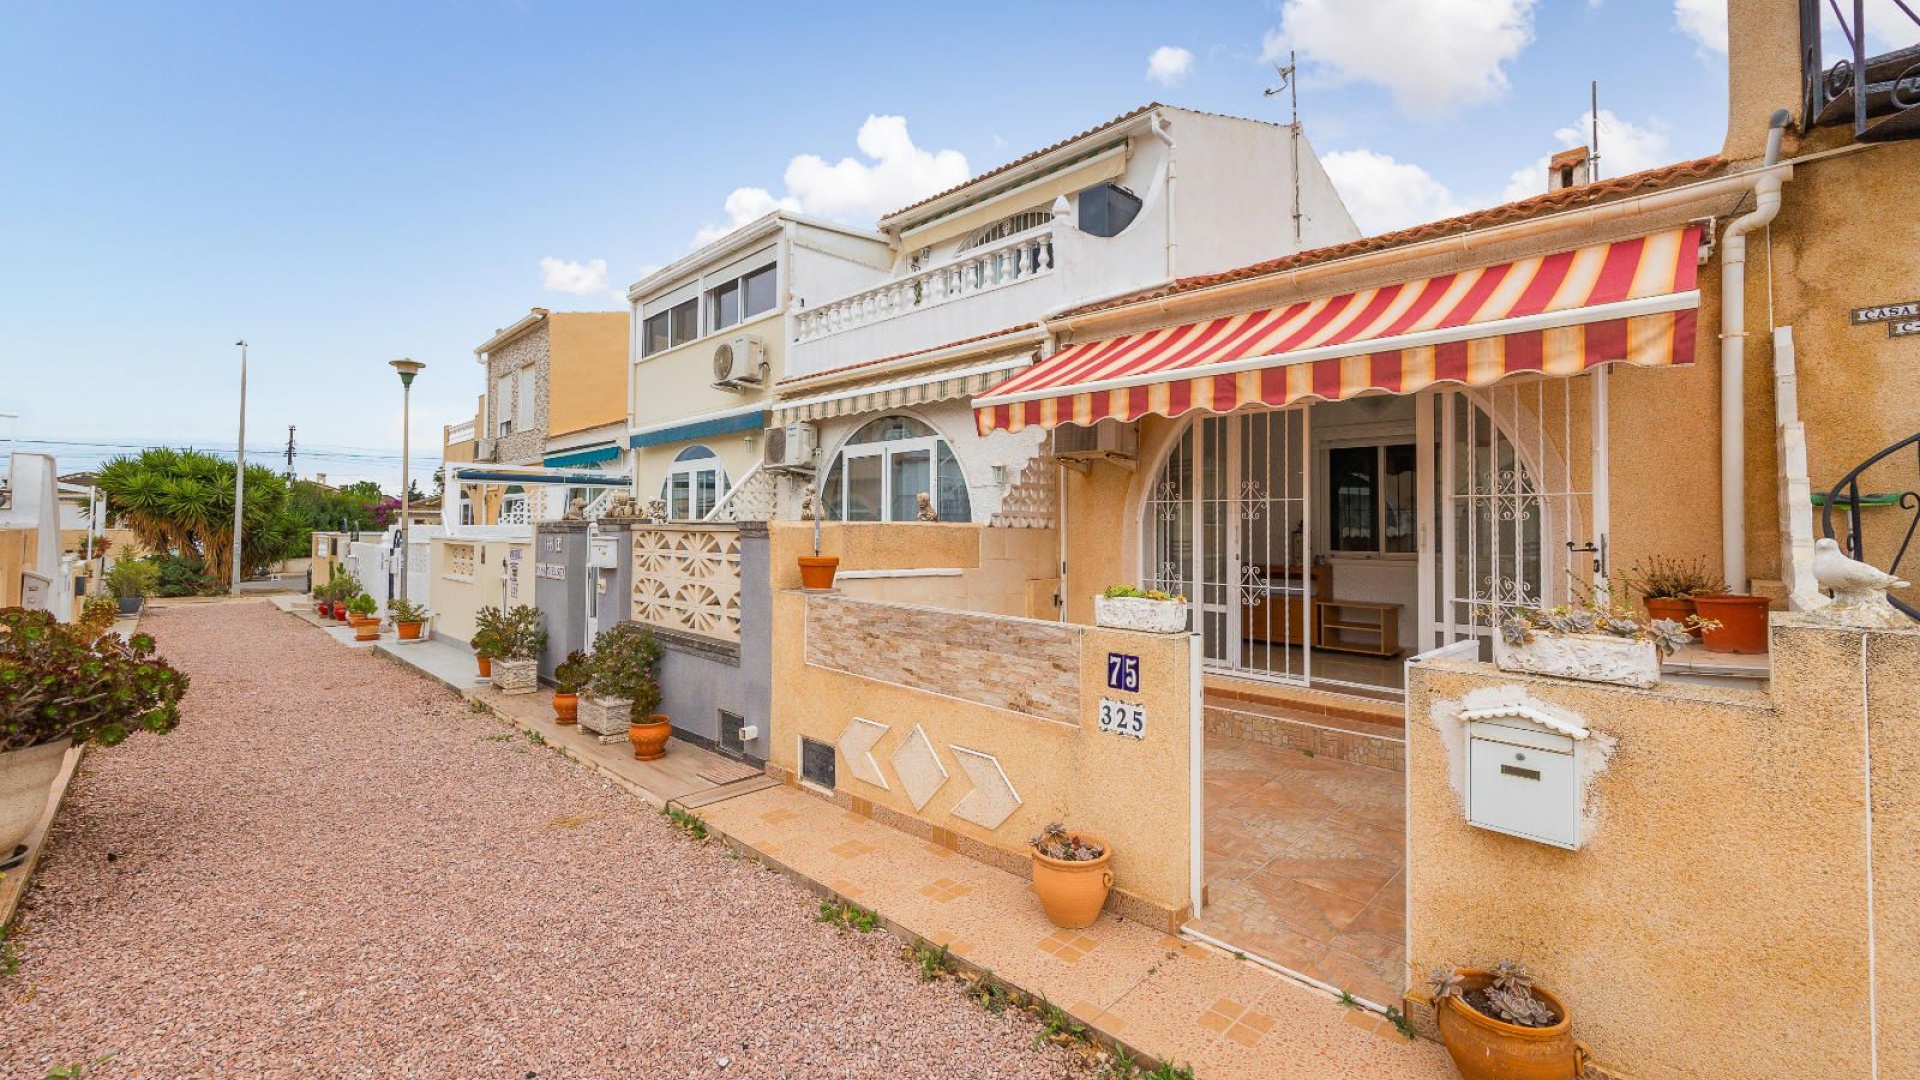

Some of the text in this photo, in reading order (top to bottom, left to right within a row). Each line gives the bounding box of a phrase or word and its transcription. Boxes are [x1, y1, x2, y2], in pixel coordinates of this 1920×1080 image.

[1864, 306, 1911, 320] CASA
[1109, 656, 1138, 689] 75
[1101, 705, 1143, 732] 325
